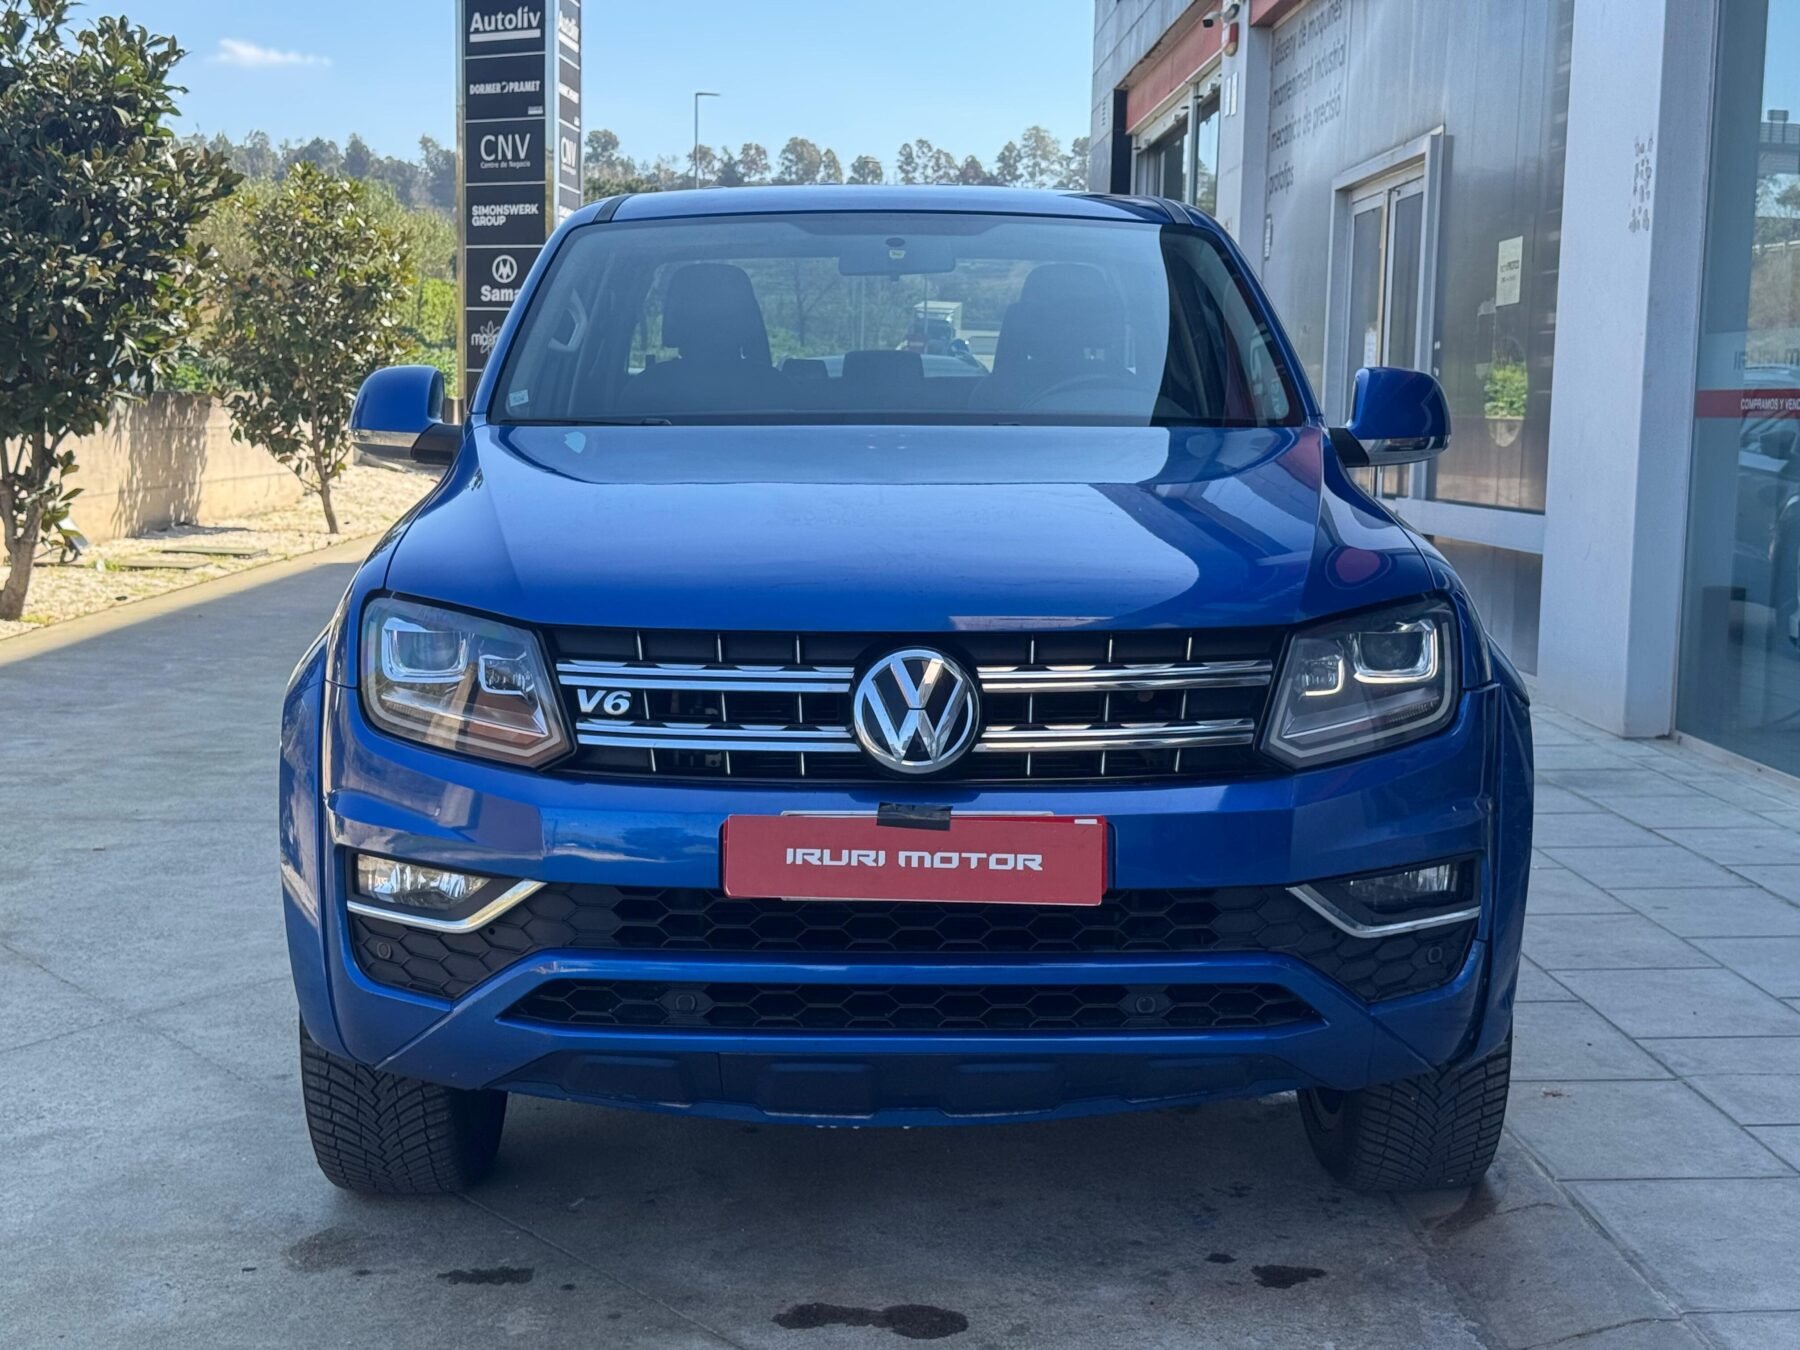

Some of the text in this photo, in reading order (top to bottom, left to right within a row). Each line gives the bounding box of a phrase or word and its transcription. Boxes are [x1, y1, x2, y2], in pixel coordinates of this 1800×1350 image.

[470, 5, 541, 33] Autoliv
[469, 80, 541, 96] DORMER PRAMET
[480, 133, 531, 161] CNV
[472, 203, 539, 216] SIMONSWERK
[472, 216, 507, 227] GROUP
[1741, 398, 1778, 410] COMPRAMOS
[1779, 398, 1784, 410] Y
[576, 689, 632, 716] V6
[786, 847, 1044, 872] IRURI MOTOR
